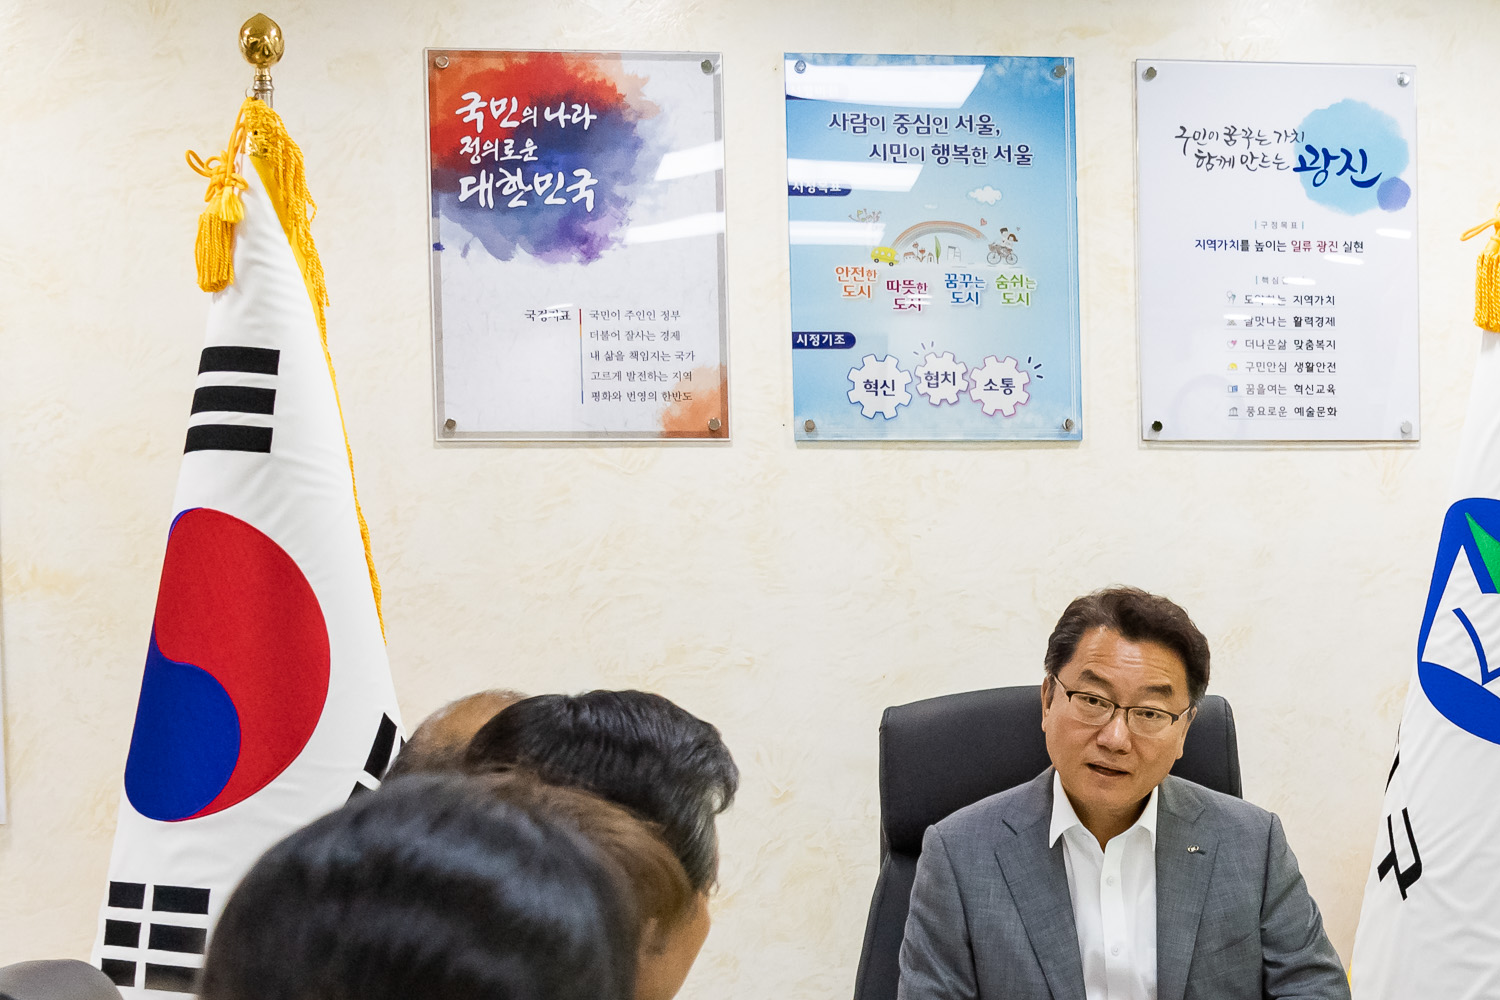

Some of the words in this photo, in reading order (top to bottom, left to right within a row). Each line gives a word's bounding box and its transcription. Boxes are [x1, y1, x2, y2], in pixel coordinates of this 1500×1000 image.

[455, 91, 538, 133] 국민의
[543, 102, 598, 131] 나라
[828, 113, 886, 135] 사람이
[892, 113, 949, 136] 중심인
[954, 114, 1001, 137] 서울,
[1174, 125, 1219, 156] 구민이
[1223, 125, 1272, 150] 꿈꾸는
[1273, 128, 1306, 144] 가치
[459, 135, 539, 164] 정의로운
[868, 143, 926, 164] 시민이
[930, 143, 989, 166] 행복한
[993, 144, 1034, 166] 서울
[1194, 149, 1235, 172] 함께
[1239, 151, 1290, 172] 만드는
[1292, 144, 1383, 189] 광진
[459, 167, 599, 213] 대한민국
[1194, 239, 1250, 252] 지역가치를
[1254, 239, 1287, 253] 높이는
[1290, 240, 1313, 253] 일류
[1316, 240, 1339, 253] 광진
[1342, 240, 1364, 253] 실현
[835, 266, 878, 283] 안전한
[944, 273, 986, 290] 꿈꾸는
[886, 279, 928, 295] 따뜻한
[995, 274, 1037, 291] 숨쉬는
[842, 285, 871, 299] 도시
[950, 291, 980, 306] 도시
[1001, 292, 1031, 306] 도시
[1292, 295, 1335, 307] 지역가치
[589, 309, 621, 321] 국민이
[624, 309, 657, 321] 주인인
[660, 309, 681, 321] 정부
[1293, 316, 1336, 328] 활력경제
[589, 330, 621, 342] 더불어
[660, 330, 681, 342] 경제
[796, 333, 846, 346] 시정기조
[1245, 339, 1287, 351] 더나은삶
[1293, 339, 1336, 351] 맞춤복지
[590, 350, 601, 362] 내
[604, 350, 625, 362] 삶을
[629, 350, 672, 362] 책임지는
[674, 350, 696, 362] 국가
[1245, 361, 1287, 373] 구민안심
[1293, 361, 1337, 373] 생활안전
[590, 370, 623, 382] 고르게
[625, 370, 668, 382] 발전하는
[672, 370, 693, 382] 지역
[923, 371, 957, 389] 협치
[862, 378, 896, 397] 혁신
[982, 377, 1016, 396] 소통
[1245, 384, 1287, 396] 꿈을여는
[1293, 384, 1337, 396] 혁신교육
[591, 391, 622, 403] 평화와
[626, 391, 657, 403] 번영의
[661, 391, 693, 403] 한반도
[1246, 406, 1288, 418] 풍요로운
[1293, 406, 1338, 418] 예술문화
